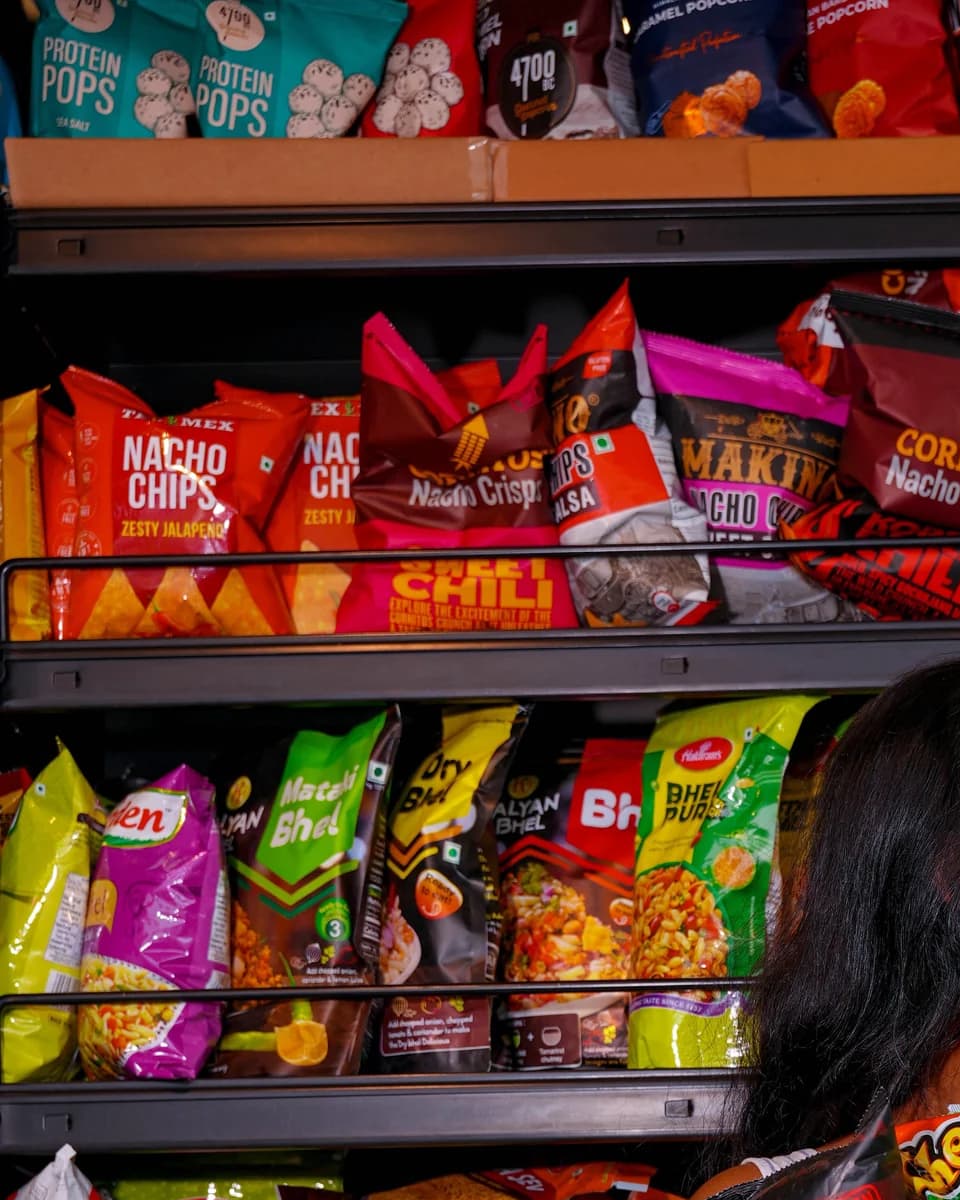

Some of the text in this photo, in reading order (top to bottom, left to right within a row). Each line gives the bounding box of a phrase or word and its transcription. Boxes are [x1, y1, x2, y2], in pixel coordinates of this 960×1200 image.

[43, 37, 122, 78] PROTEIN
[511, 51, 555, 101] 4700
[42, 65, 117, 115] POPS
[201, 56, 273, 98] PROTEIN
[197, 84, 268, 137] POPS
[181, 417, 234, 432] MEX
[123, 436, 227, 475] NACHO
[128, 473, 217, 511] CHIPS
[121, 520, 158, 538] ZESTY
[303, 509, 343, 525] ZESTY
[392, 572, 553, 609] CHILI
[421, 754, 472, 780] Dry
[495, 816, 546, 835] BHEL
[329, 920, 342, 938] 3
